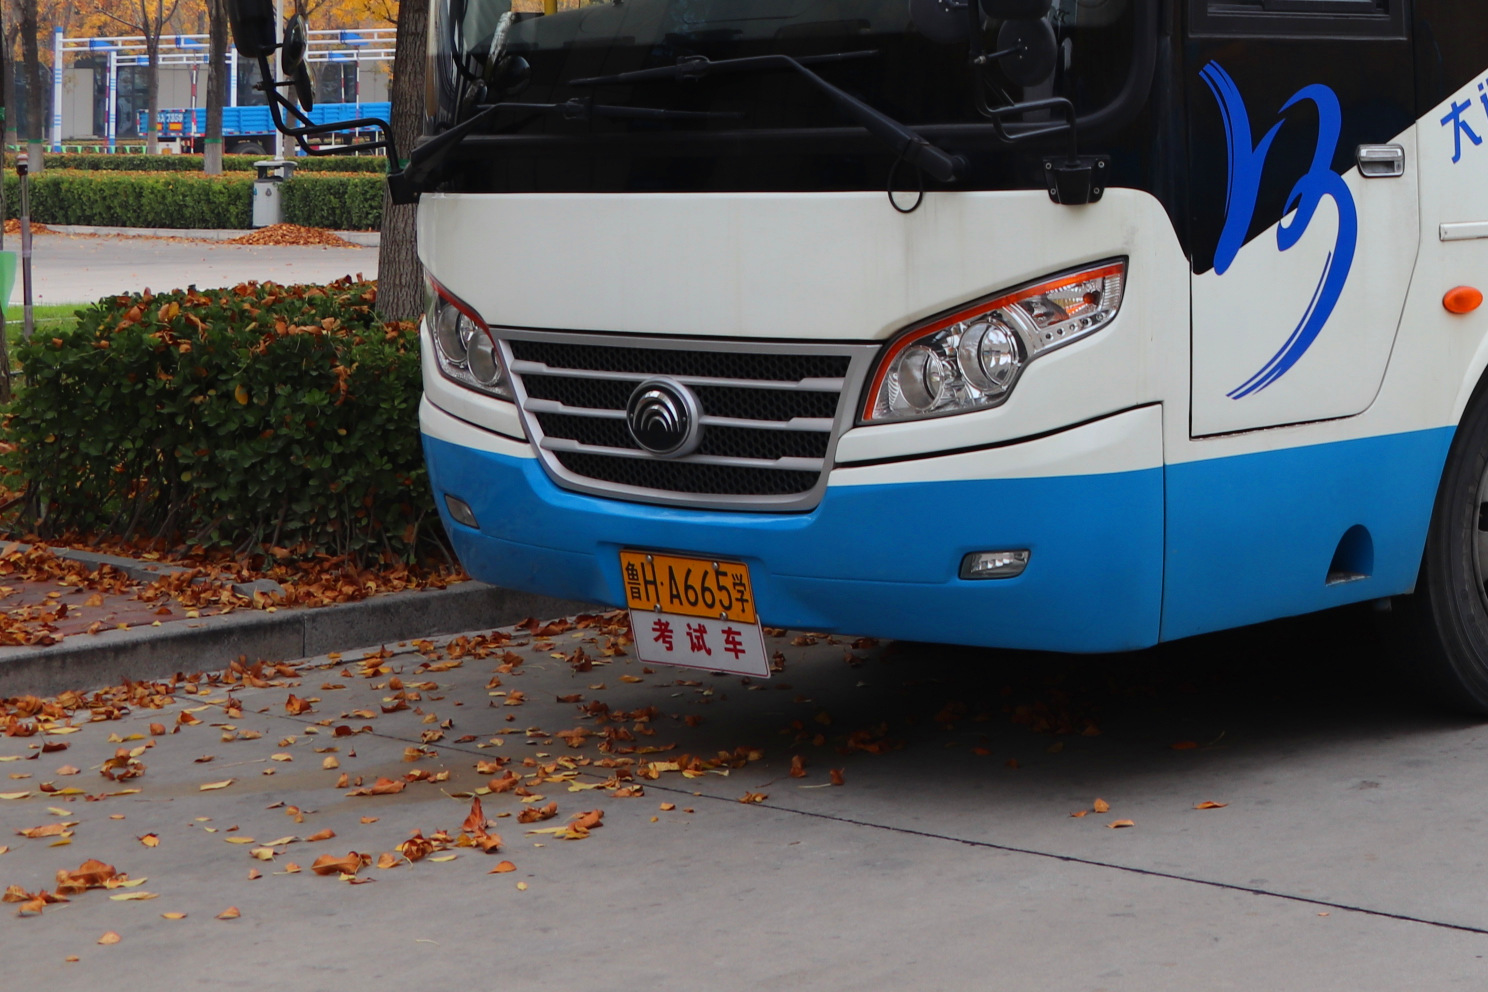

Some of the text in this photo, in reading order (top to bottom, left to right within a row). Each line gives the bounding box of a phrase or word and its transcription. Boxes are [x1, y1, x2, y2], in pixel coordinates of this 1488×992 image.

[625, 561, 749, 613] 鲁H·A665学
[652, 618, 746, 660] 考试车
